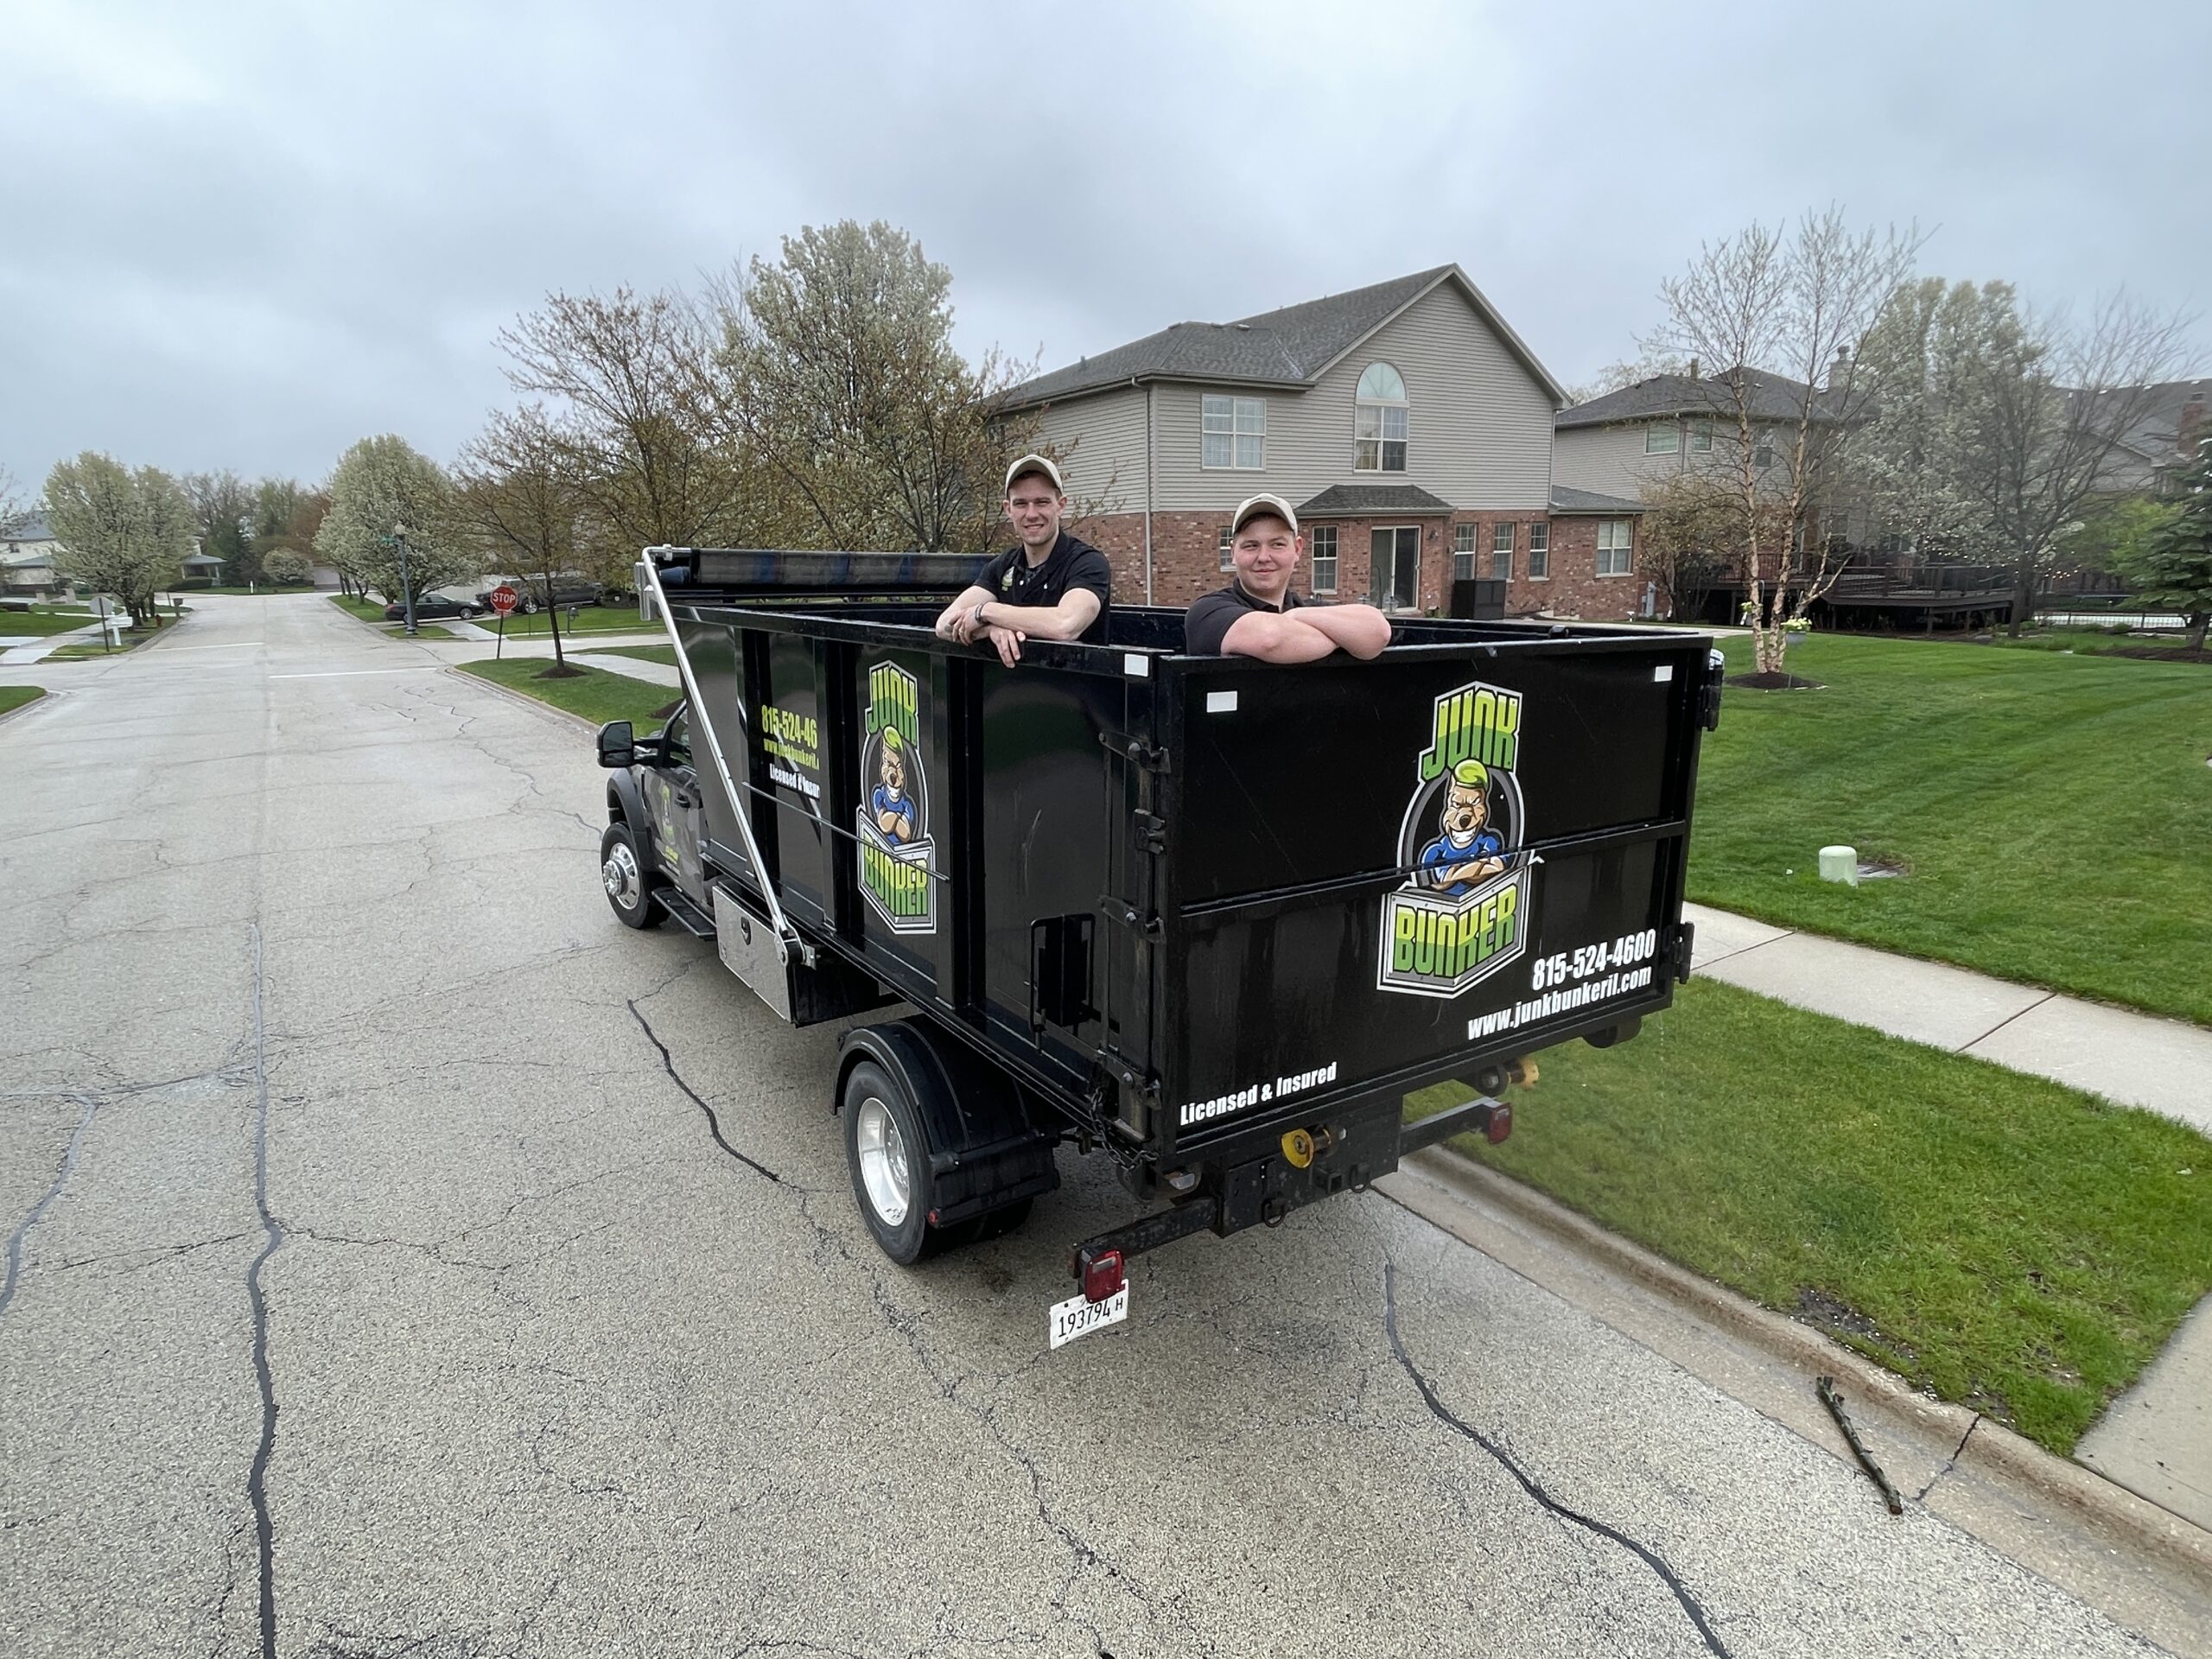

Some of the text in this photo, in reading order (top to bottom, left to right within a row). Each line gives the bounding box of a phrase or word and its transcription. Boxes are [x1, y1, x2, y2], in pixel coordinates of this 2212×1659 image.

[493, 592, 516, 603] STOP
[761, 704, 818, 750] 815-524-46
[867, 666, 918, 747] JUNK
[1422, 689, 1518, 781] JUNK
[769, 762, 797, 789] Licensed
[864, 831, 928, 916] BUNKER
[1394, 884, 1517, 977] BUNKER
[1532, 928, 1656, 991] 815-524-4600
[1468, 966, 1652, 1040] www.junkbunkeril.com
[1180, 1061, 1338, 1126] Licensed & Insured
[1058, 1297, 1123, 1338] 193794 H
